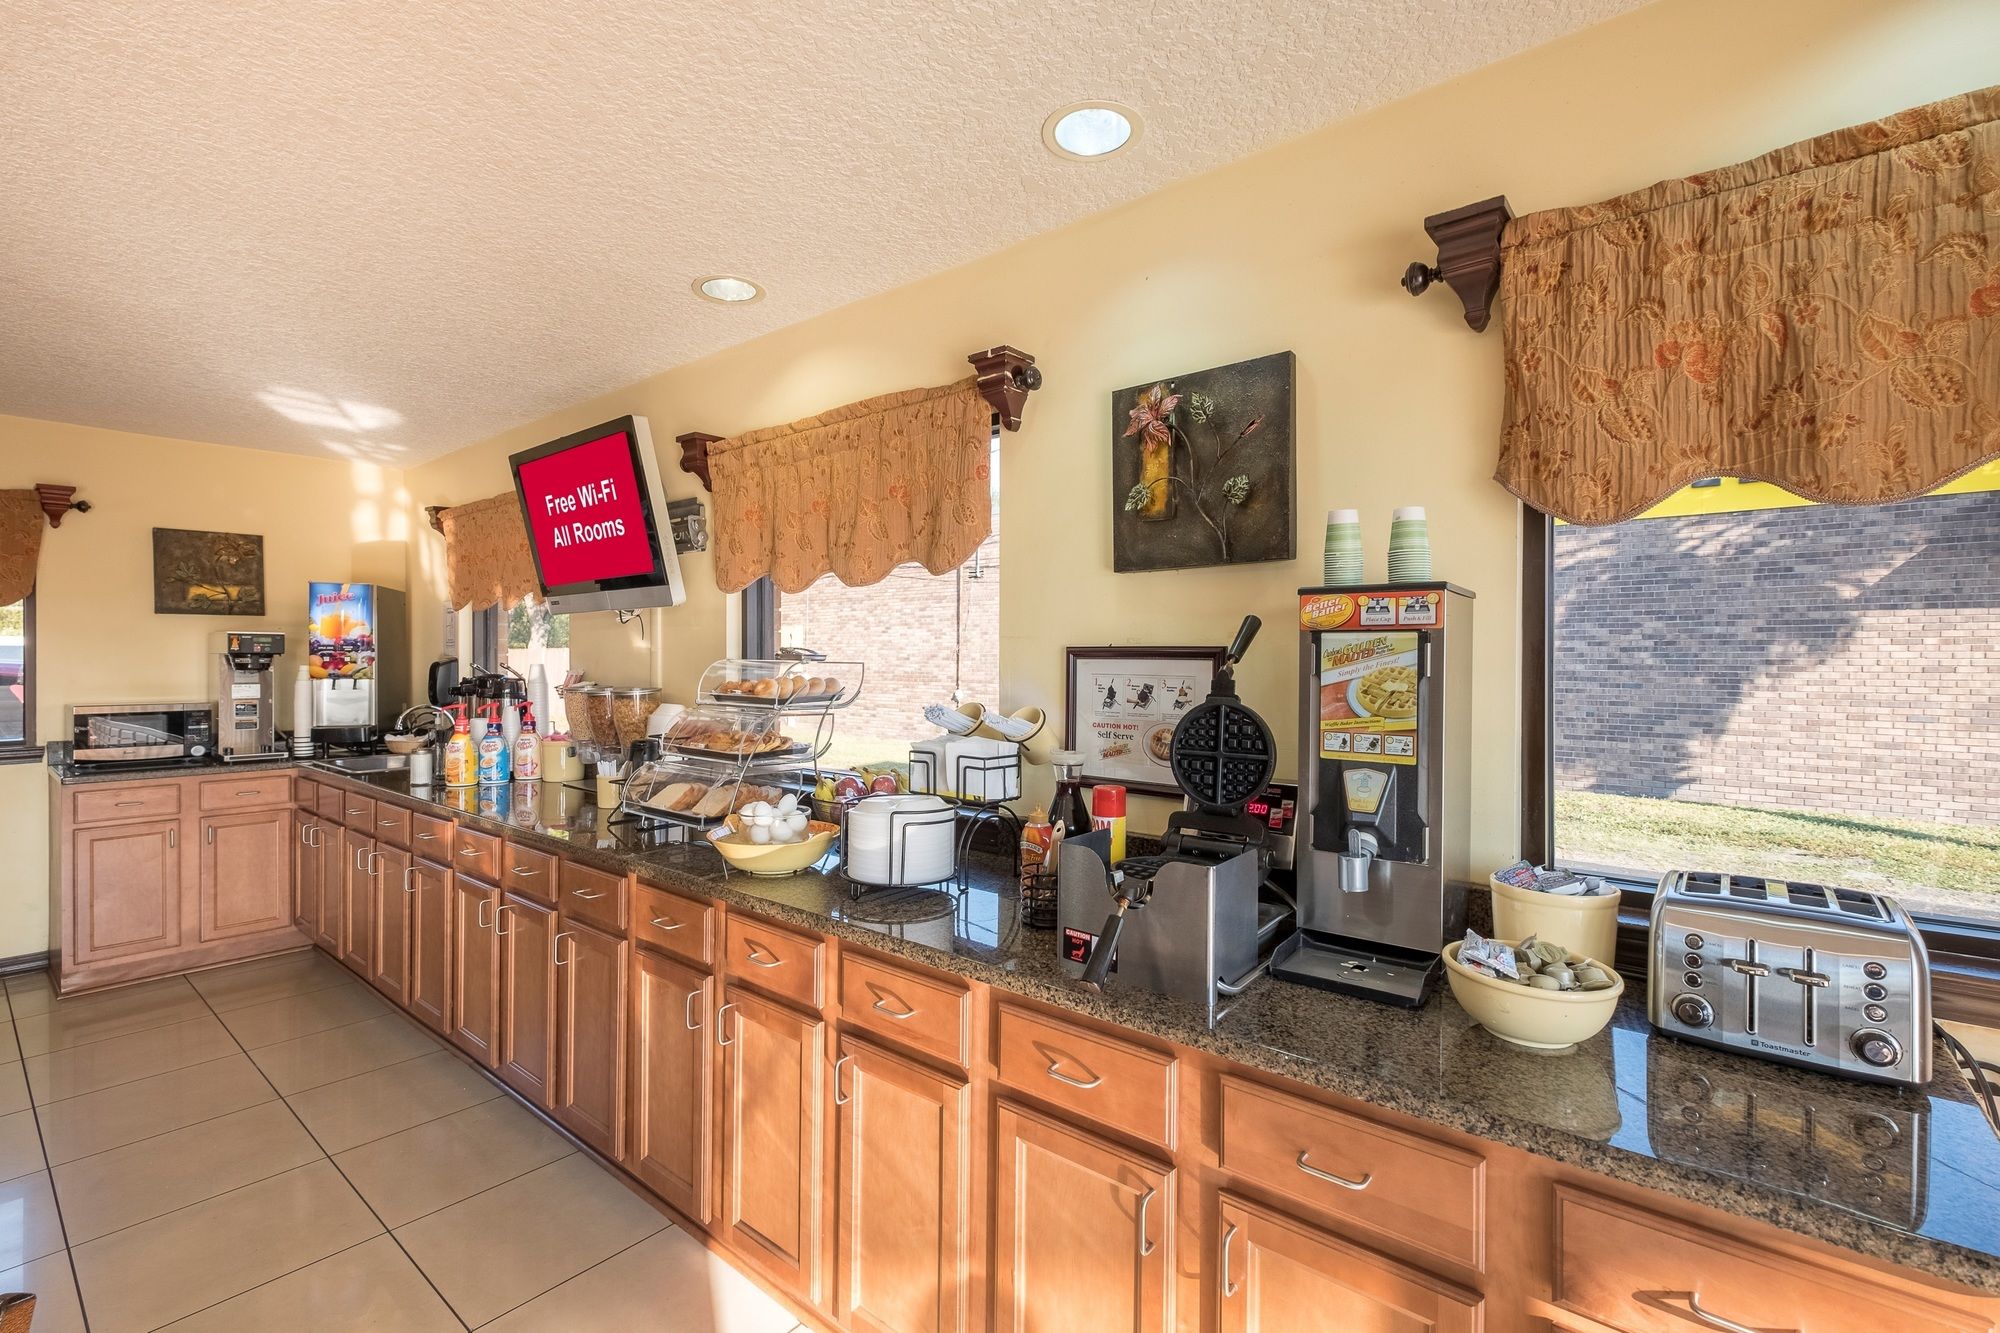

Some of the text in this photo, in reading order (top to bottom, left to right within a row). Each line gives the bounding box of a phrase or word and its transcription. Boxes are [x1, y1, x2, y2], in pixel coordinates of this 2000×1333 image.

[545, 478, 617, 516] Free Wi-Fi
[553, 518, 626, 549] All Rooms
[316, 592, 354, 607] Juice
[1305, 597, 1341, 613] Better
[1312, 603, 1347, 619] Batter
[1343, 636, 1388, 655] GOLDEN
[1332, 648, 1376, 667] MALTED
[1337, 657, 1400, 678] Simply the Finest!
[1126, 678, 1132, 687] 2
[1162, 679, 1167, 689] 3
[1092, 722, 1139, 731] CAUTION HOT!
[1097, 731, 1134, 740] Self Serve
[1065, 928, 1091, 941] CAUTION
[1071, 937, 1083, 945] HOT
[1760, 1041, 1811, 1057] Toastmaster
